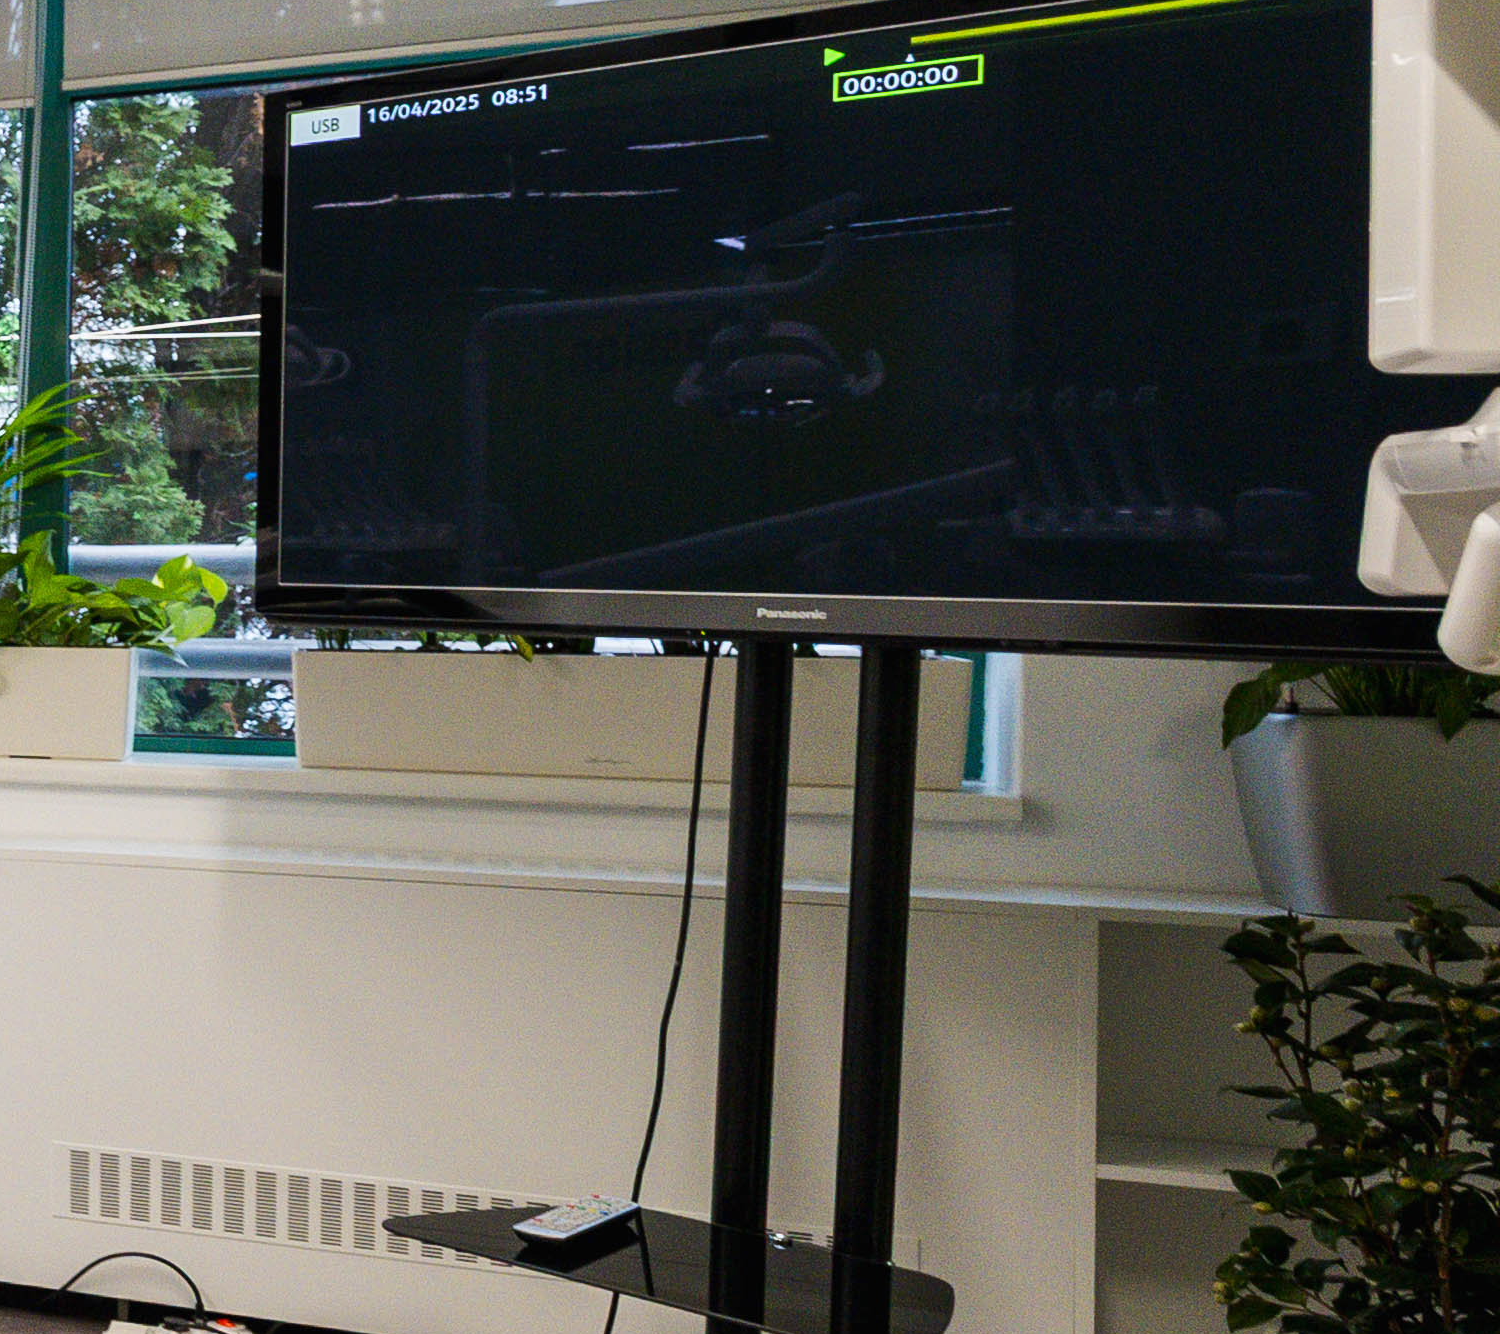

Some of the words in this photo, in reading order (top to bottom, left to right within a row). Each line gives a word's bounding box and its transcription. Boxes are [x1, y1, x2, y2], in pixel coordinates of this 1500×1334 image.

[843, 64, 959, 95] 00:00:00
[367, 93, 480, 124] 16/04/2025
[491, 83, 549, 107] 08:51
[311, 118, 340, 135] USB
[756, 607, 828, 620] Panasonic
